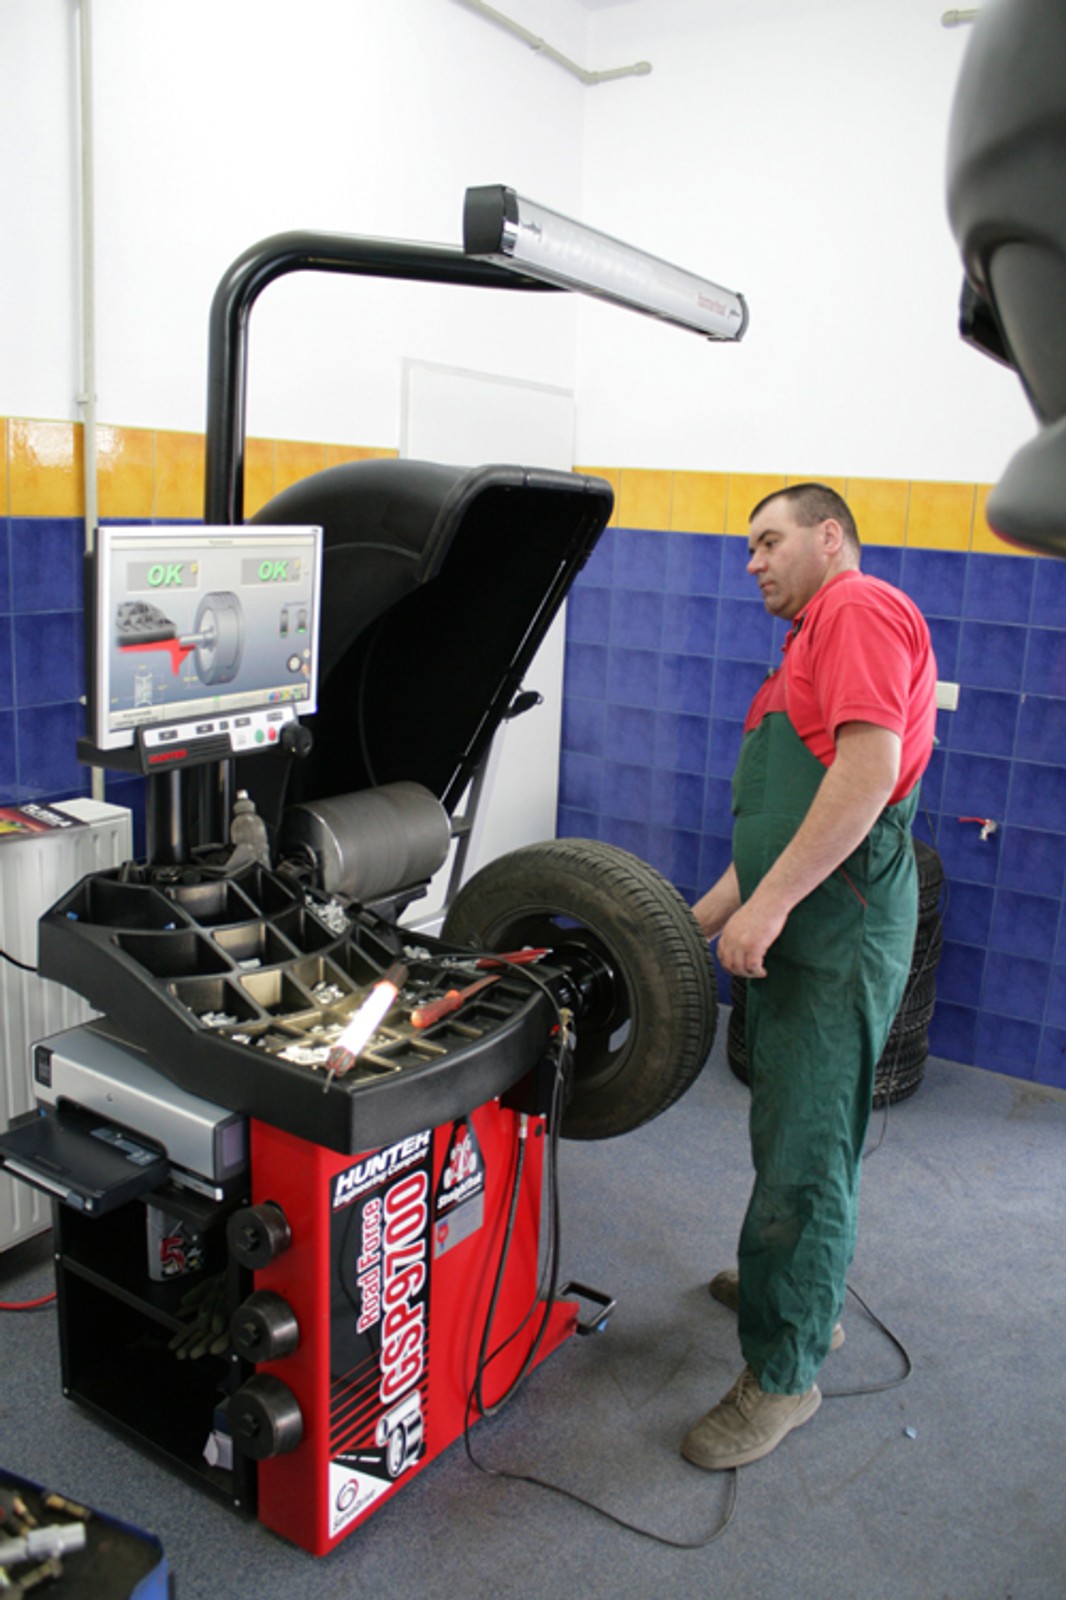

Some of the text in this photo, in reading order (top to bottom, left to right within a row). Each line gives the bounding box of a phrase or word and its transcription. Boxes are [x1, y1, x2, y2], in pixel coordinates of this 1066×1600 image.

[148, 564, 184, 587] OK
[258, 560, 288, 582] OK
[336, 1130, 431, 1195] HUNTER
[356, 1197, 383, 1334] Road Force
[381, 1170, 428, 1403] GSP9700
